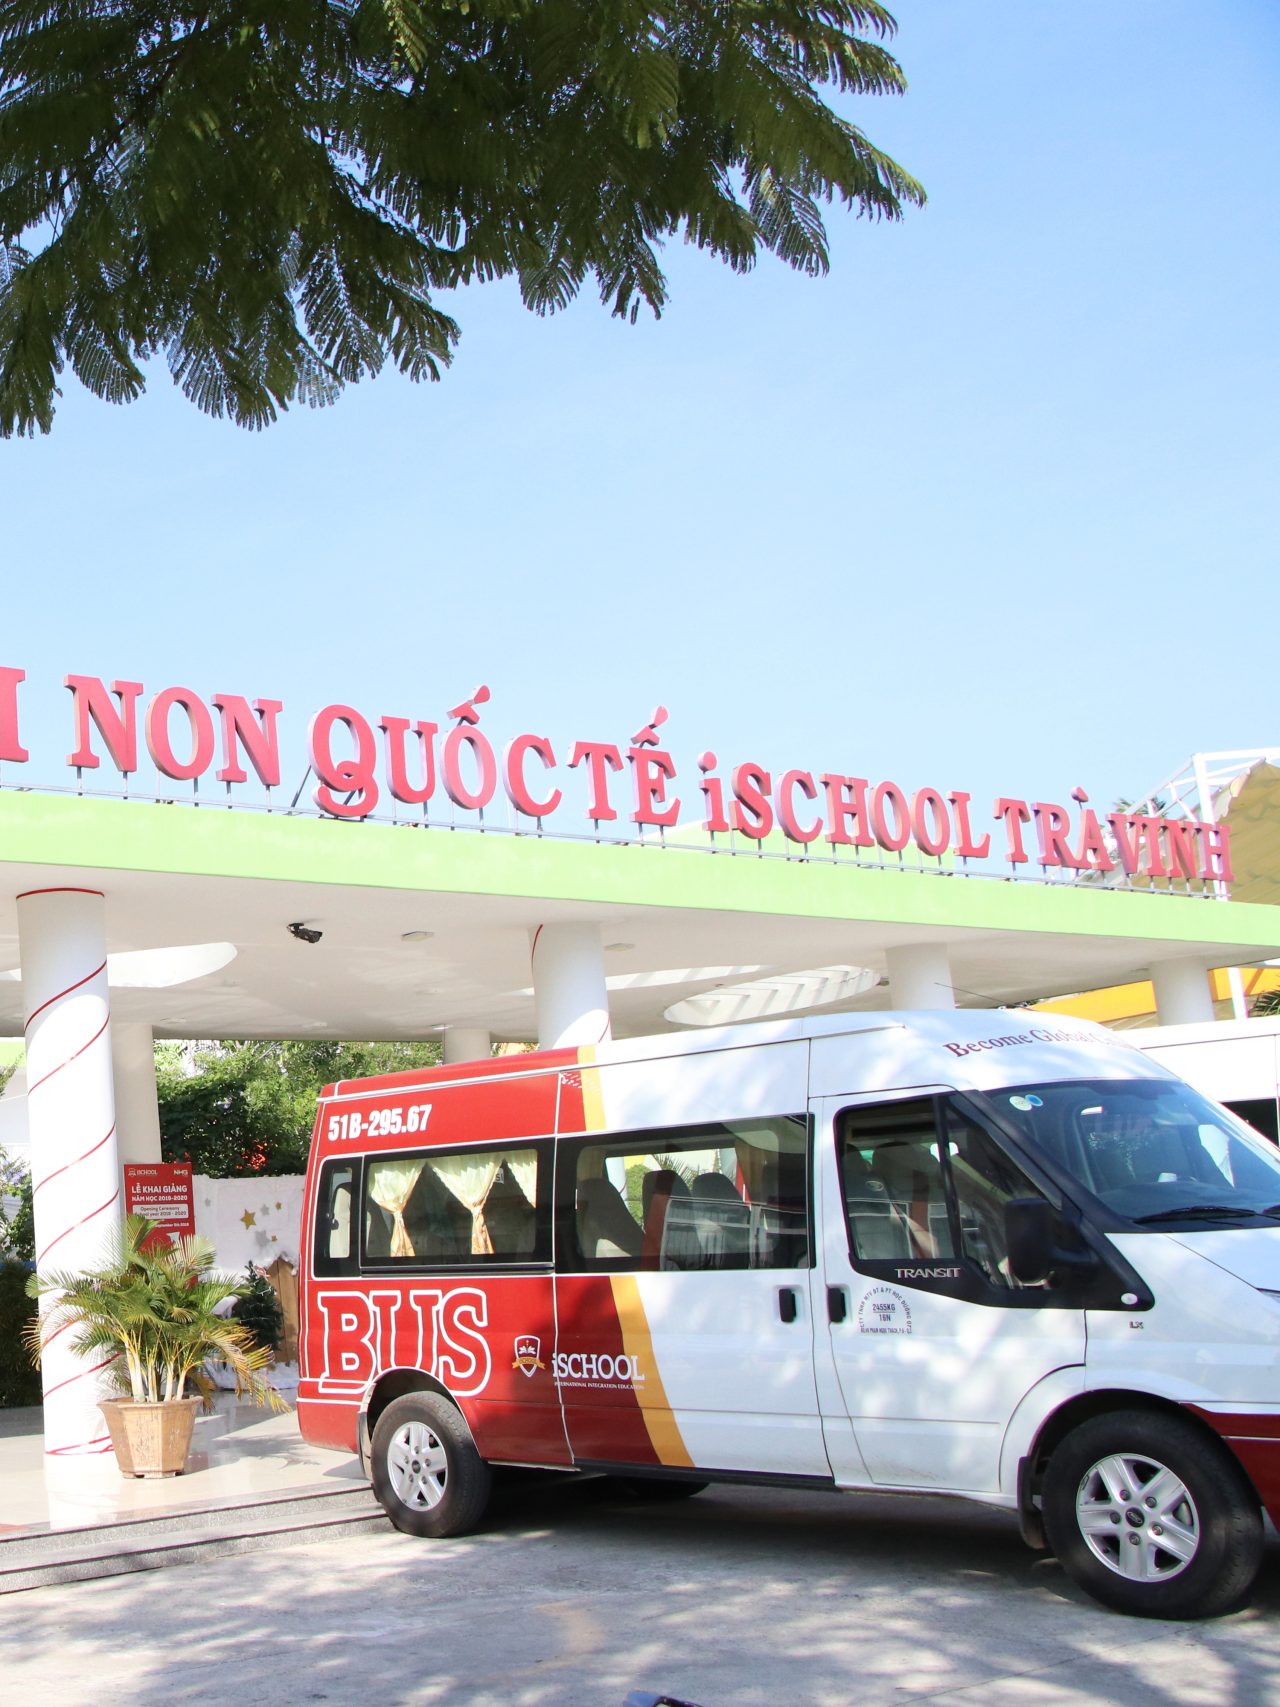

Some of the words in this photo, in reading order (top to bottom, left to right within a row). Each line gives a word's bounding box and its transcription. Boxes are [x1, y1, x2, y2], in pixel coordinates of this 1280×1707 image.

[64, 674, 284, 788] NON
[307, 685, 562, 818] QUỐC
[566, 706, 681, 827] TẾ
[698, 751, 991, 859] iSCHOOL
[942, 1033, 1032, 1057] Become
[328, 1104, 432, 1142] 51B-295.67
[142, 1185, 162, 1194] KHAI
[894, 1267, 960, 1278] TRANSIT
[317, 1287, 492, 1397] BUS
[552, 1352, 646, 1381] iSCHOOL
